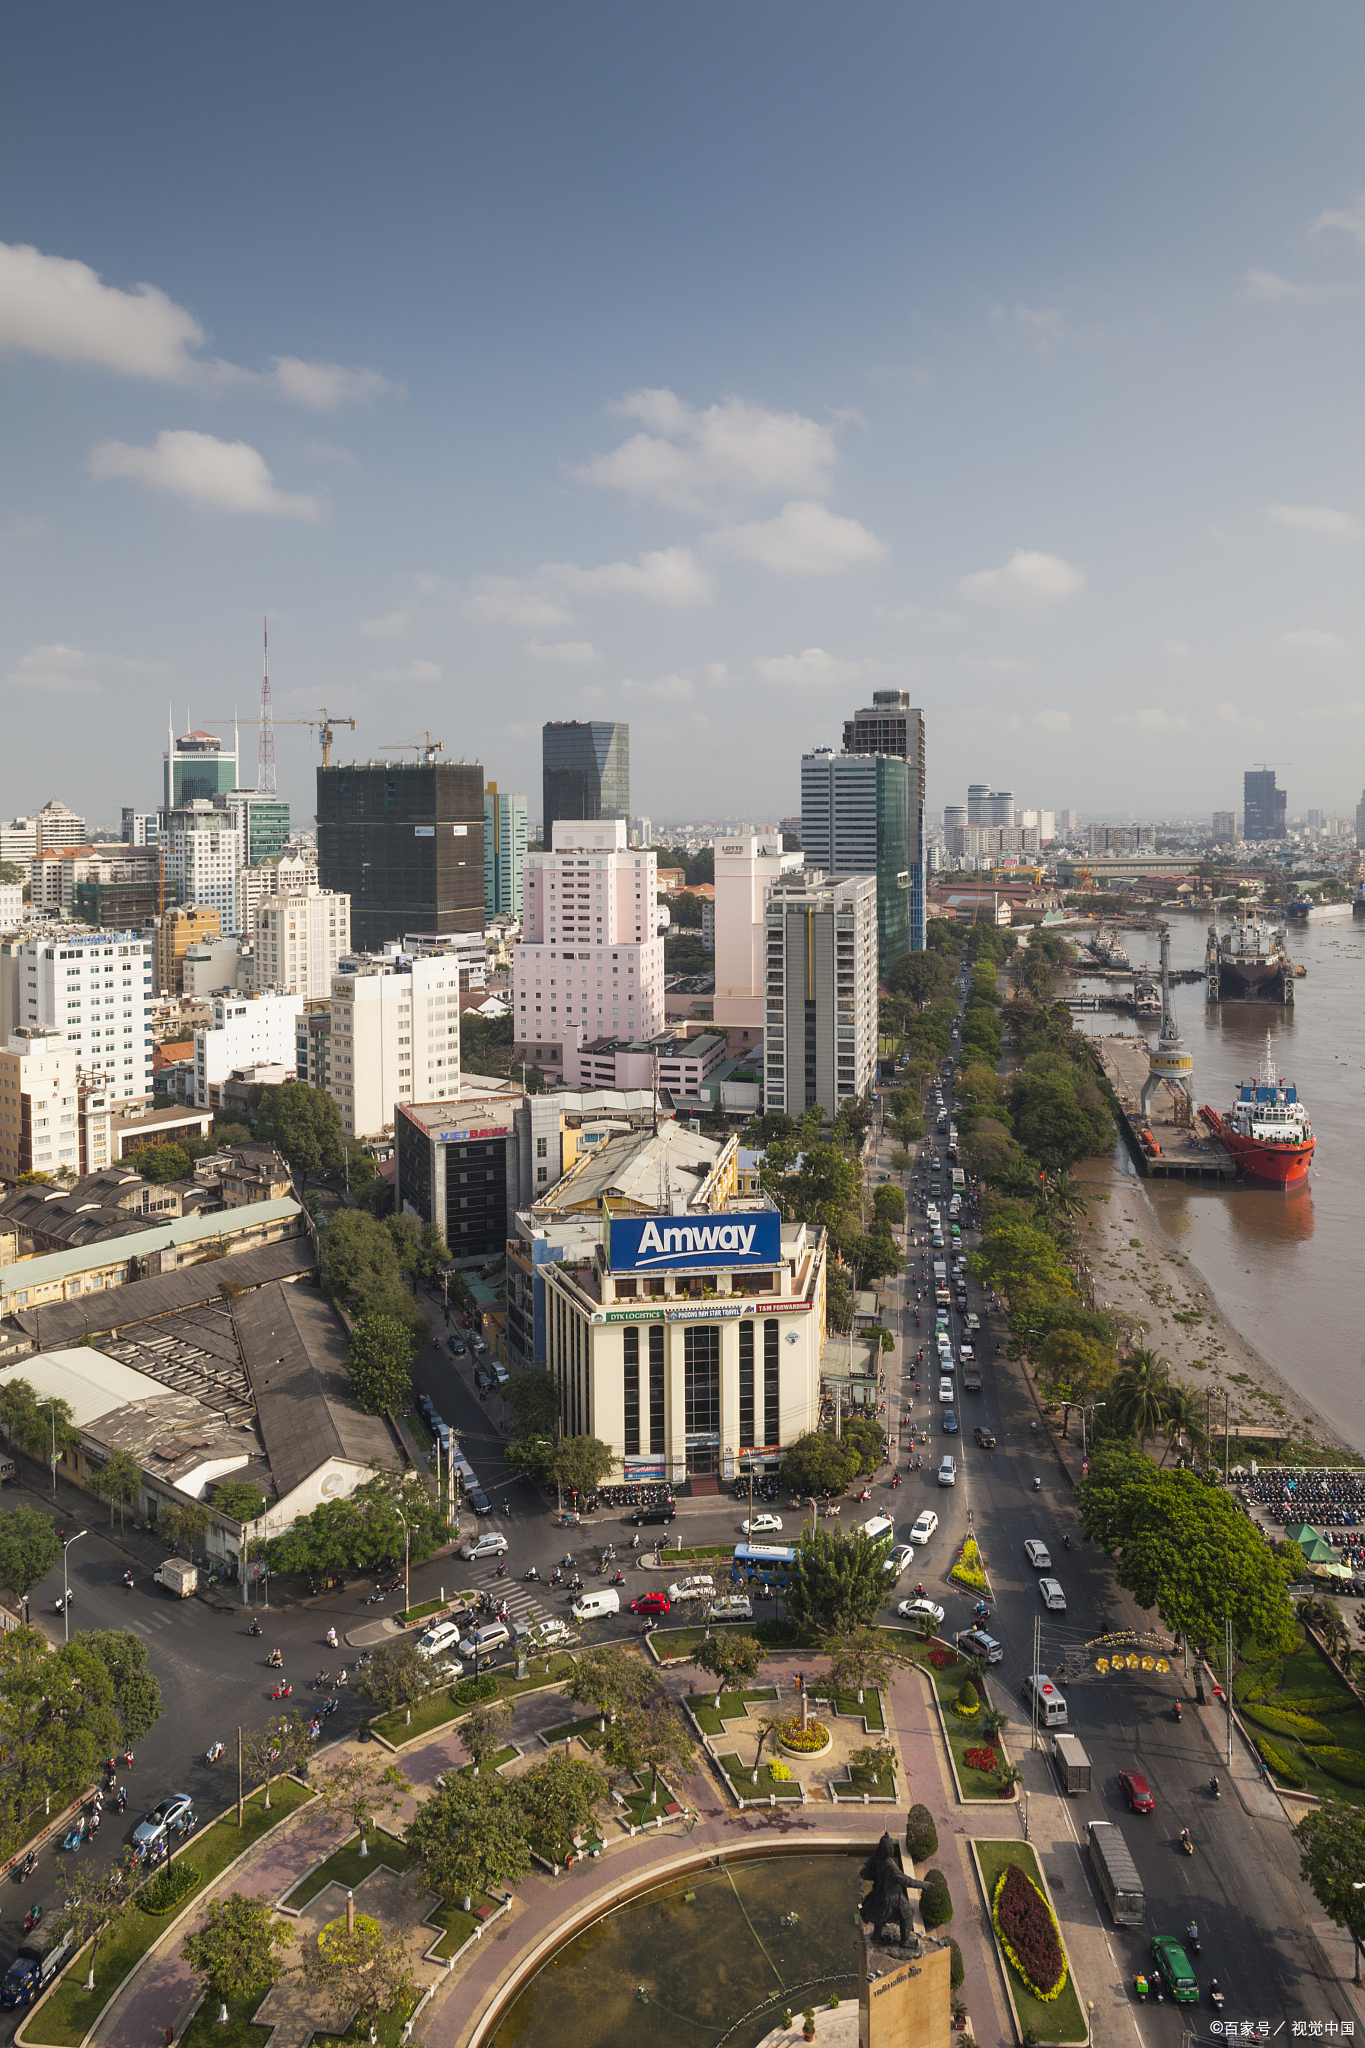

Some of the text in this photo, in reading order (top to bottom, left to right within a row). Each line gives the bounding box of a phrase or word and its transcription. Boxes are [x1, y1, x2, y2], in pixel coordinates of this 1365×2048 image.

[110, 931, 138, 943] HOTEL
[440, 1126, 508, 1141] VIETBANK
[637, 1221, 757, 1256] Amway
[773, 1303, 810, 1311] FORWARDING
[625, 1312, 660, 1320] LOGISTICS
[709, 1309, 721, 1317] STAR
[722, 1308, 740, 1316] TRAVEL
